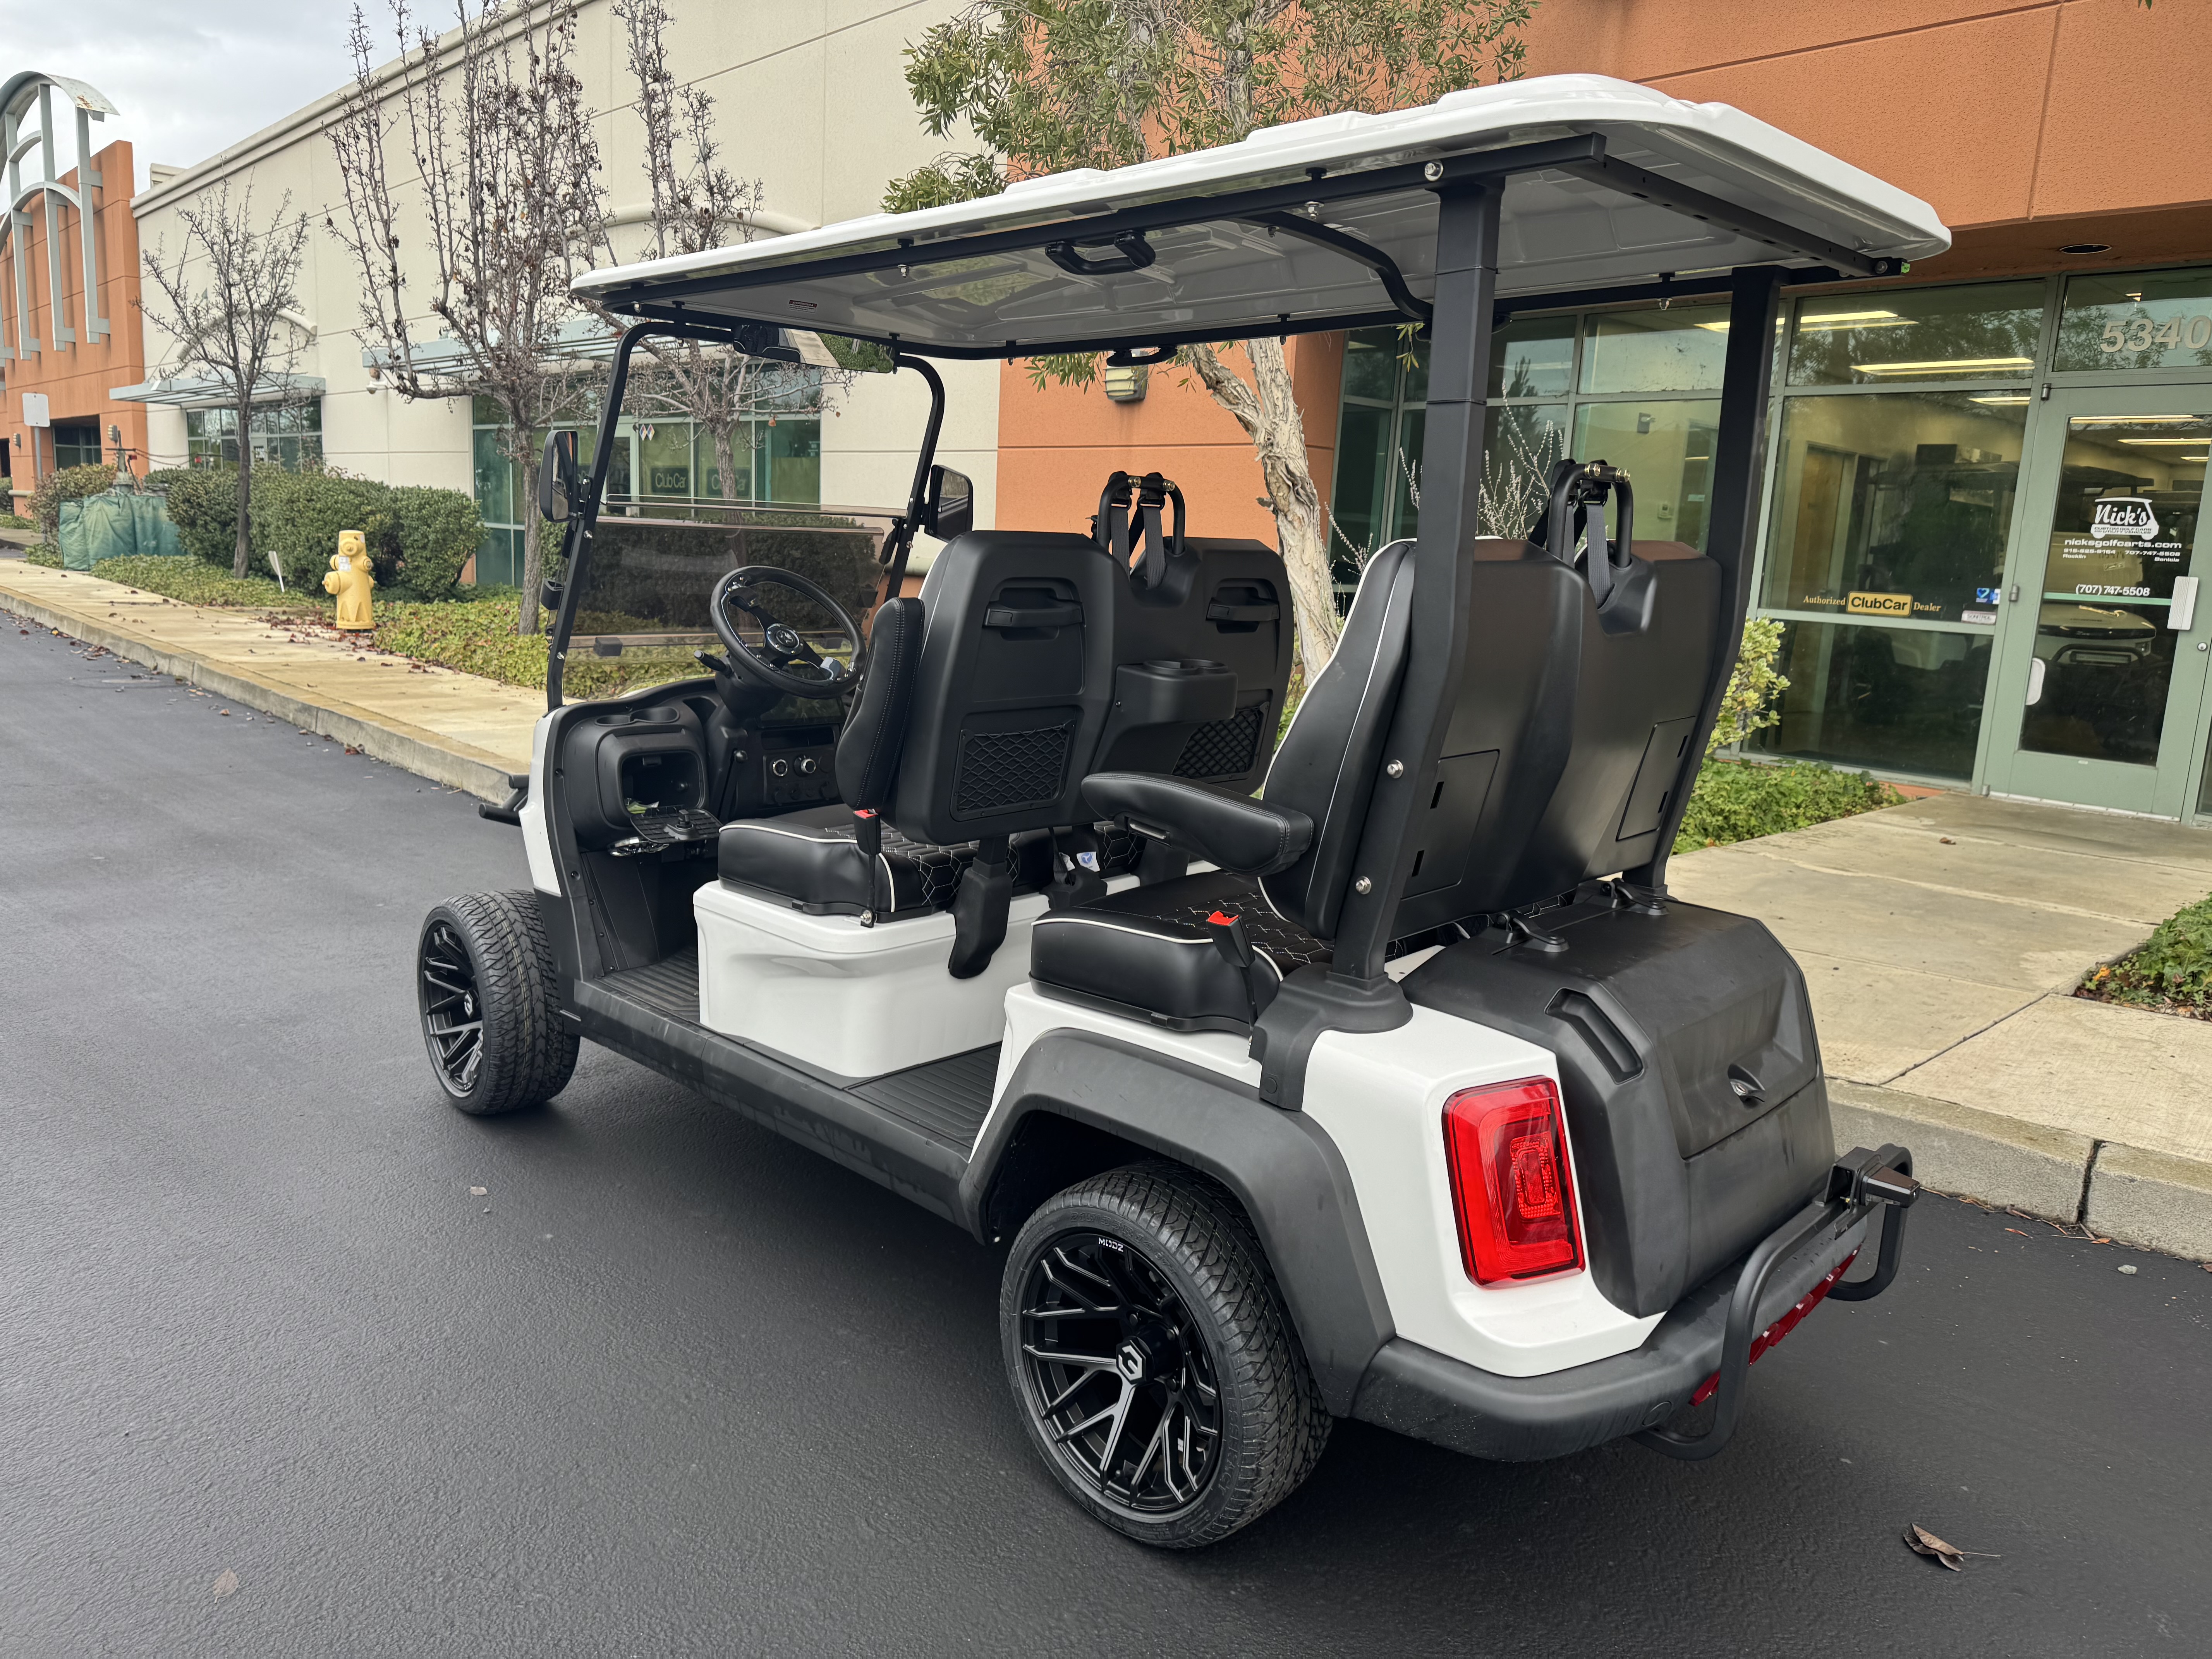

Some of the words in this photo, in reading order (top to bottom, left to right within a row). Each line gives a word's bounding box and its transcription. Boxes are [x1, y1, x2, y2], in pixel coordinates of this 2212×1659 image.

[2100, 315, 2212, 353] 5340
[2095, 504, 2147, 526] Nick's
[2064, 538, 2182, 548] nicksgolfcarts.com
[2076, 584, 2102, 596] (707)
[2104, 586, 2150, 596] 747-5508
[1803, 595, 1846, 606] Authorized
[1851, 596, 1908, 611] ClubCar
[1913, 602, 1942, 612] Dealer
[1098, 1237, 1124, 1252] MODZ
